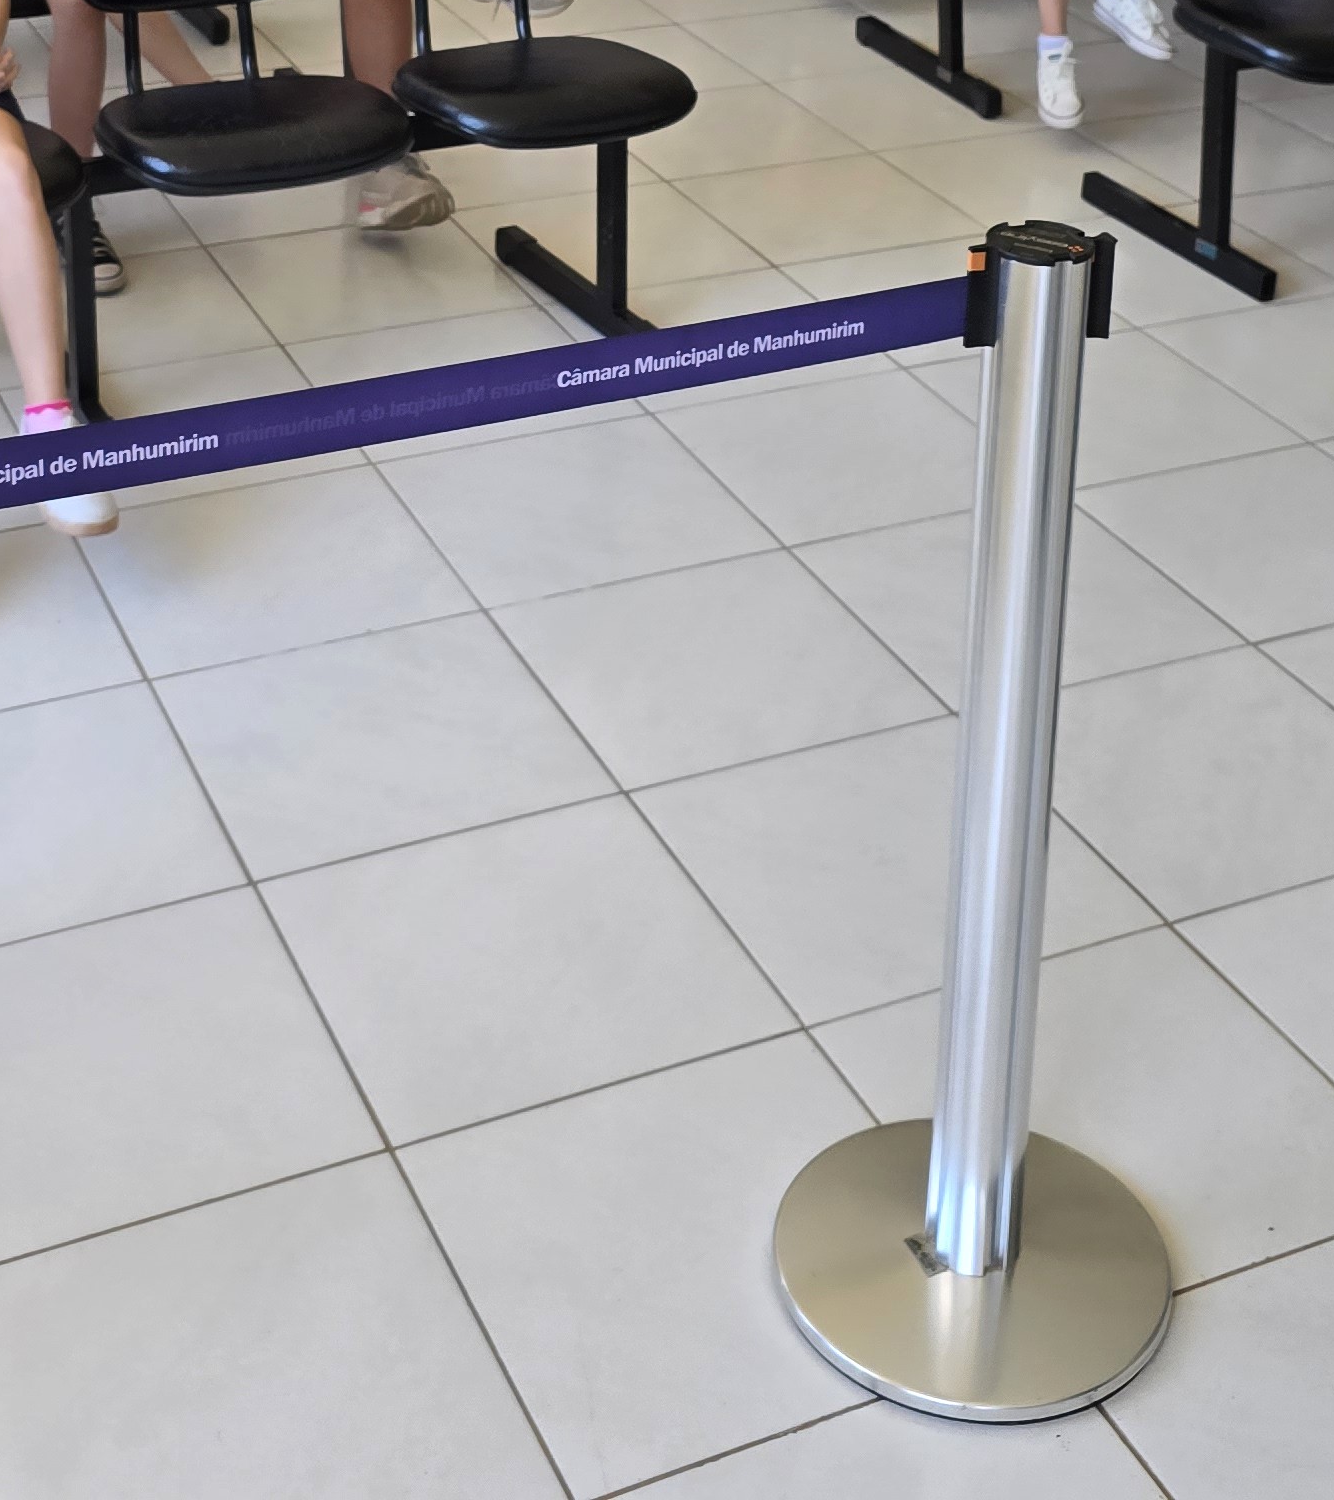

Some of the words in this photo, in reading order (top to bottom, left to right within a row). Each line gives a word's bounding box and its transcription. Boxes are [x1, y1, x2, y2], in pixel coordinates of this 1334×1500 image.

[557, 363, 630, 388] Câmara
[634, 344, 724, 376] Municipal
[727, 340, 750, 359] de
[754, 320, 865, 354] Manhumirim
[50, 455, 78, 475] de
[82, 432, 219, 470] Manhumirim
